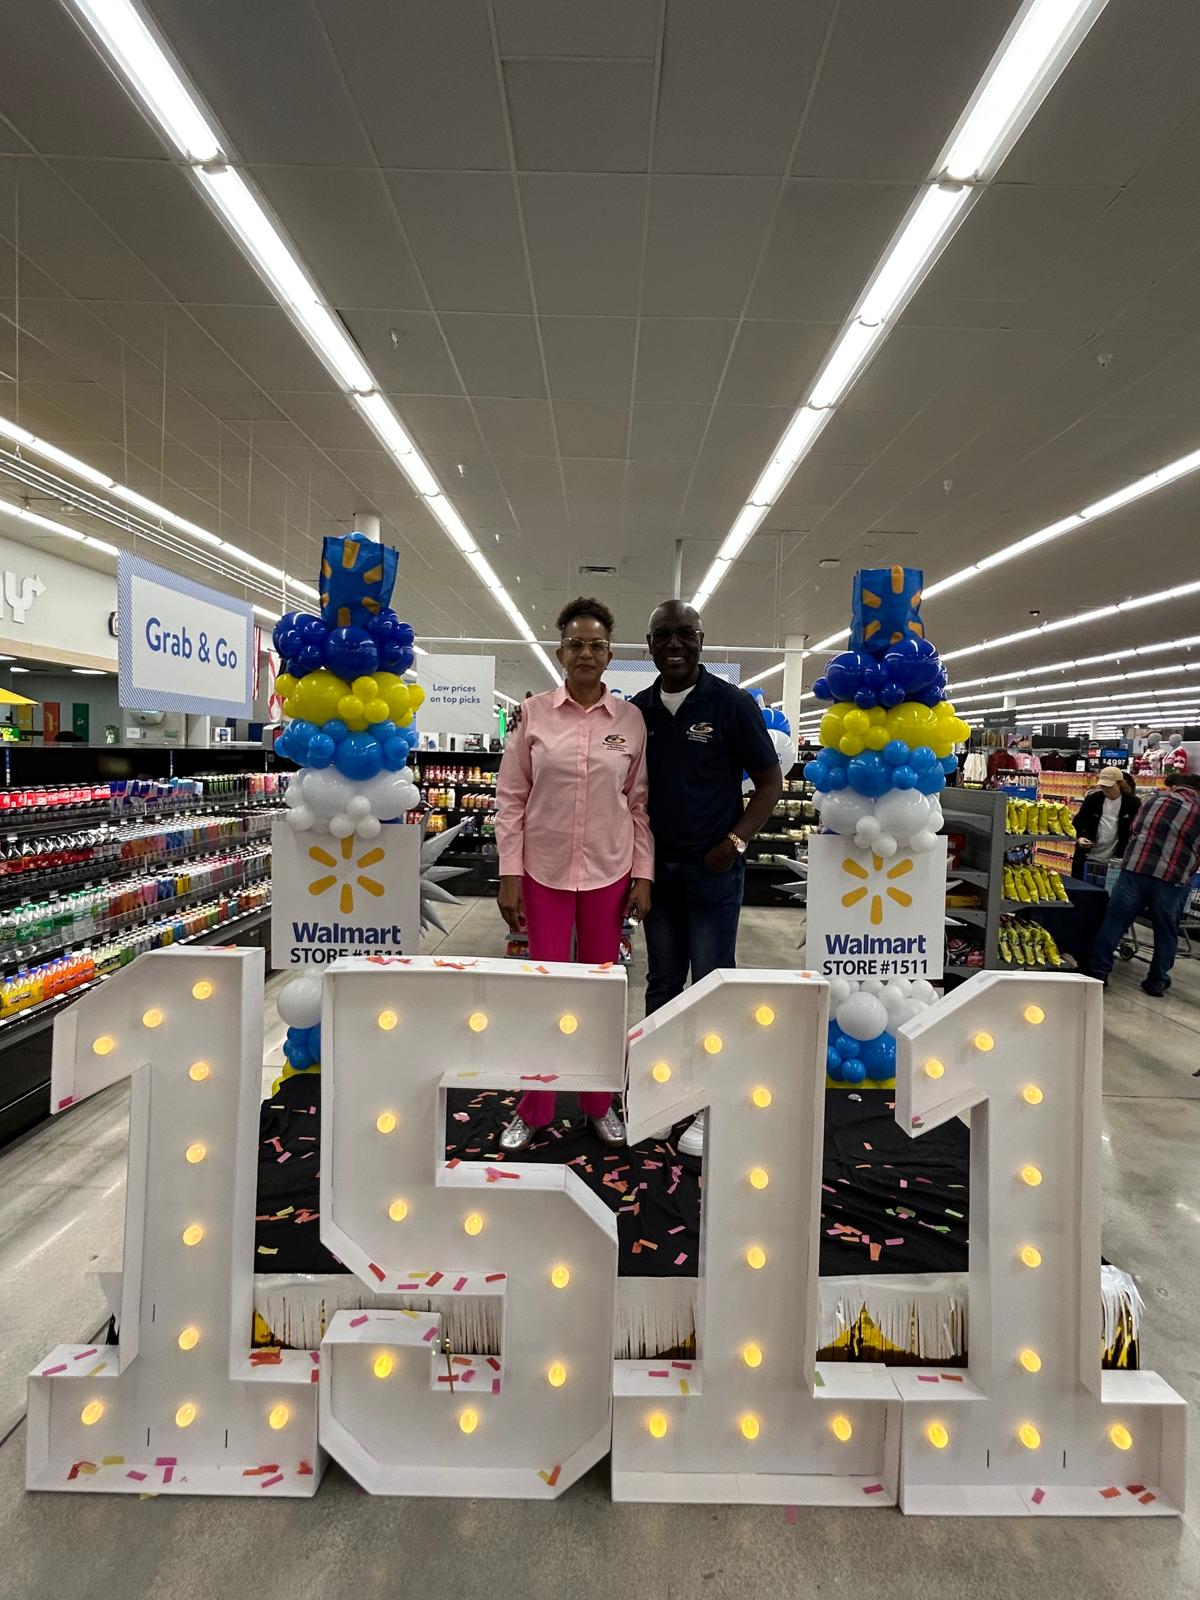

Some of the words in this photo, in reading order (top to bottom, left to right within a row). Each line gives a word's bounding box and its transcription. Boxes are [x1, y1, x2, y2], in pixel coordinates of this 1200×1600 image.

[146, 617, 193, 659] Grab
[198, 632, 210, 663] &
[216, 638, 237, 669] Go
[433, 684, 449, 692] Low
[451, 684, 476, 693] prices
[443, 696, 457, 705] top
[459, 696, 480, 705] picks
[292, 922, 402, 945] Walmart
[825, 934, 927, 955] Walmart
[823, 960, 877, 976] STORE
[880, 959, 928, 975] #1511
